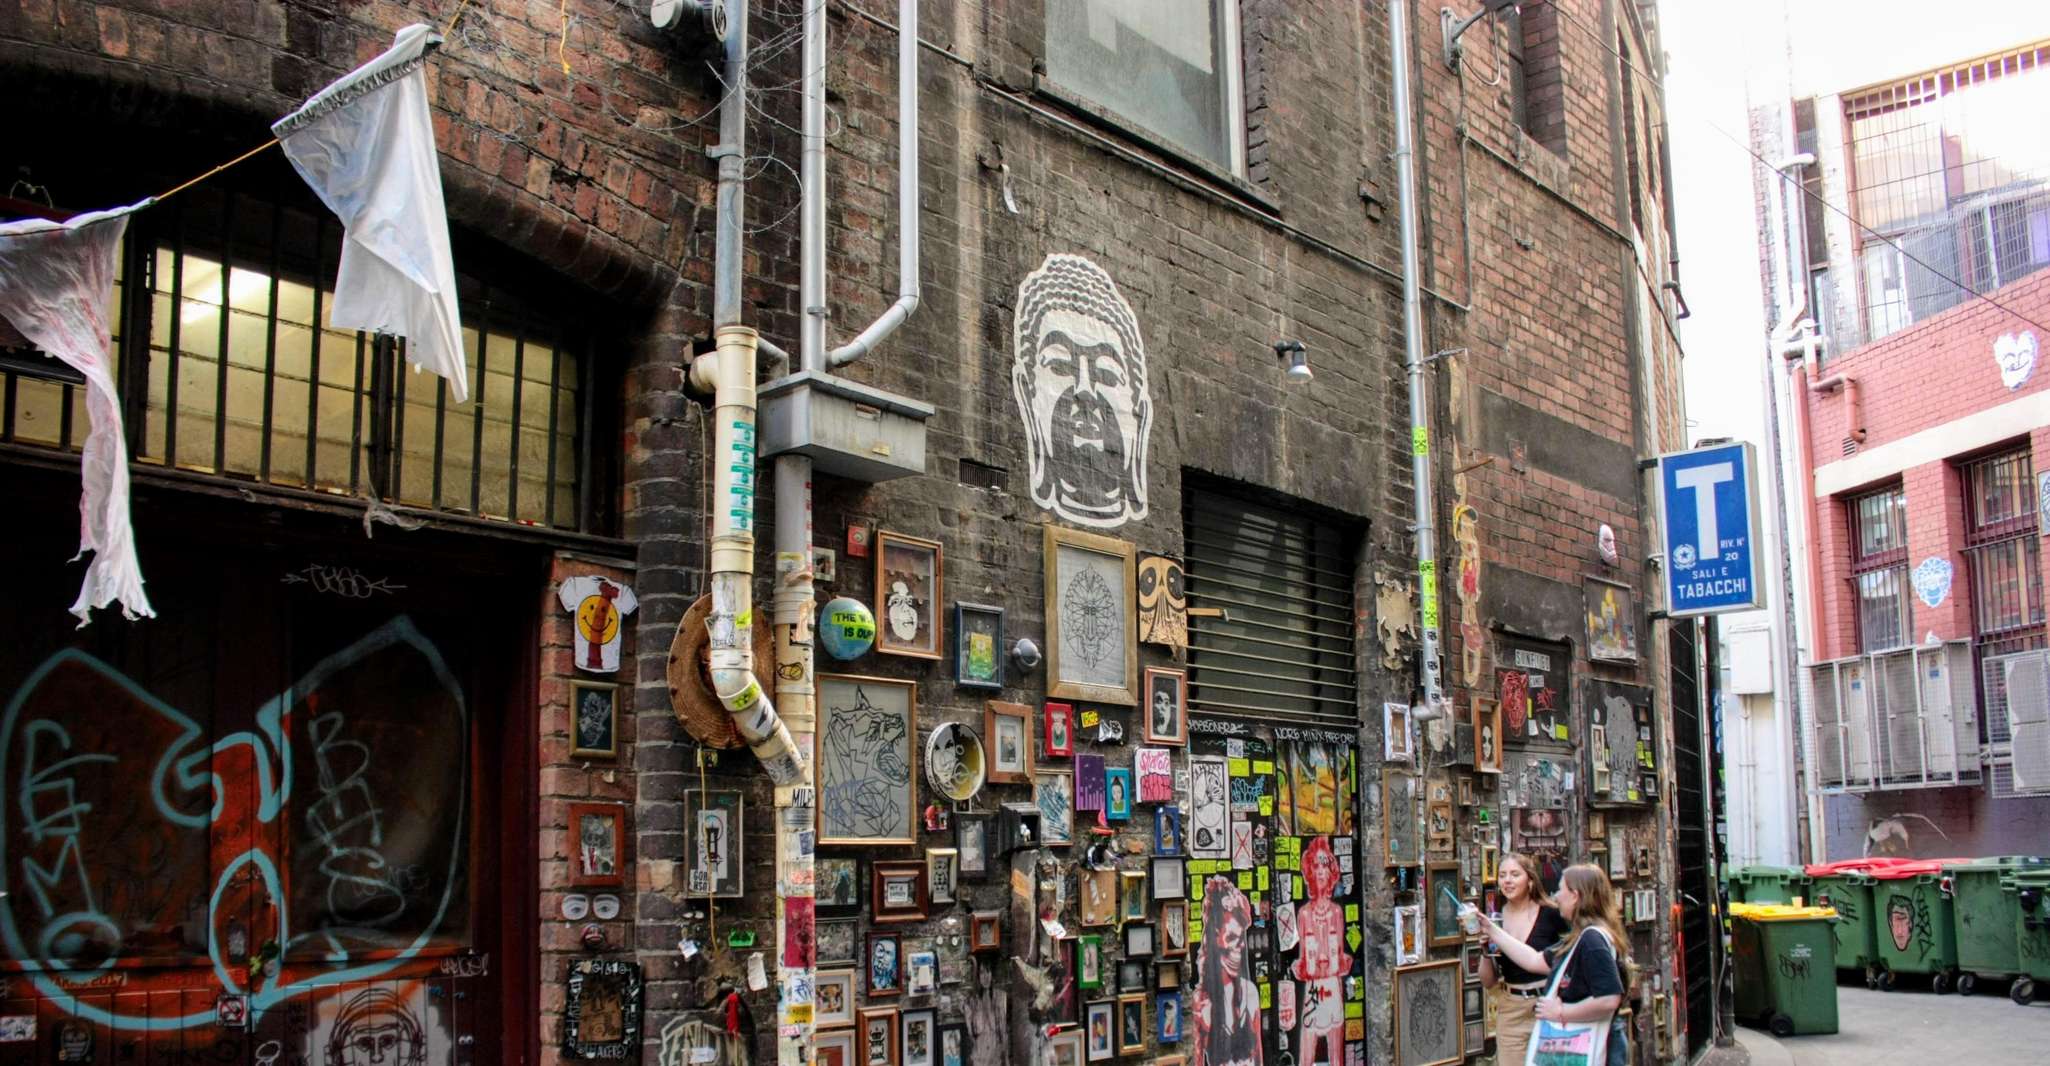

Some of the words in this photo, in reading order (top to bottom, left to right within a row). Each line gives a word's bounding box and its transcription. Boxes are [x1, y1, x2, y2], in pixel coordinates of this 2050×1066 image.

[1675, 462, 1734, 560] T
[1725, 552, 1739, 561] 20
[1691, 568, 1716, 580] SALI
[1721, 567, 1729, 576] E
[1677, 577, 1747, 600] TABACCHI
[835, 612, 857, 623] THE
[844, 627, 854, 638] IS
